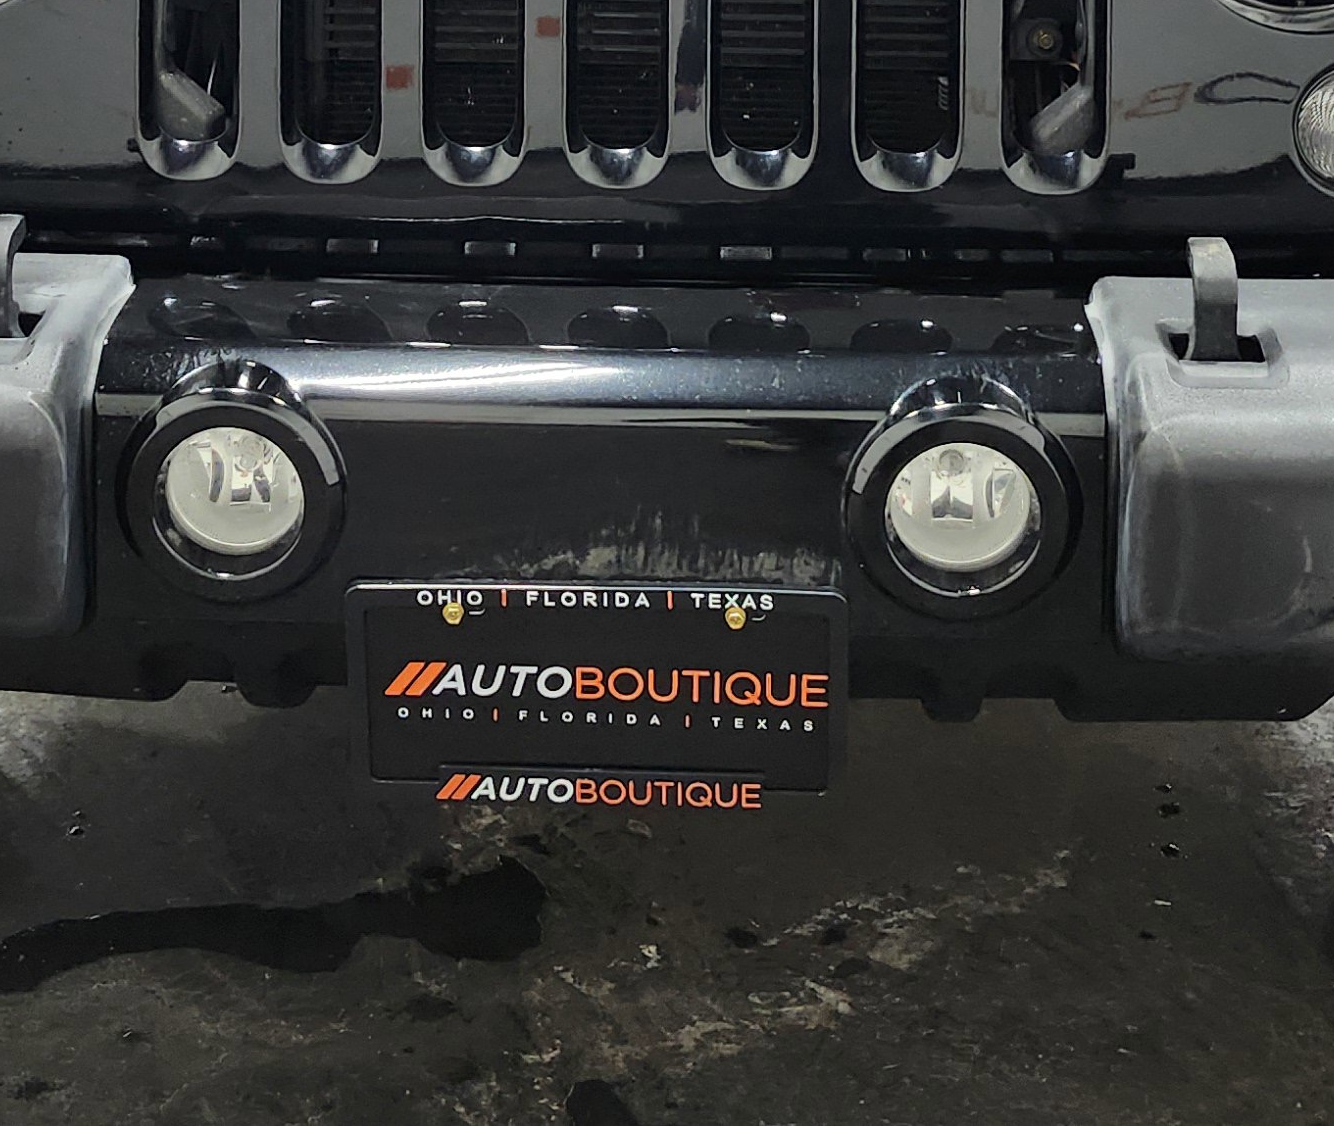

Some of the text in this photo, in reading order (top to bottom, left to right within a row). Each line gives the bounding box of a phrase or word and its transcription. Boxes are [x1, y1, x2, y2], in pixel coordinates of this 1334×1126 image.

[416, 587, 774, 610] OHIO FLORIDA TEXAS
[397, 706, 814, 732] OHIO FLORIDA TEXAS
